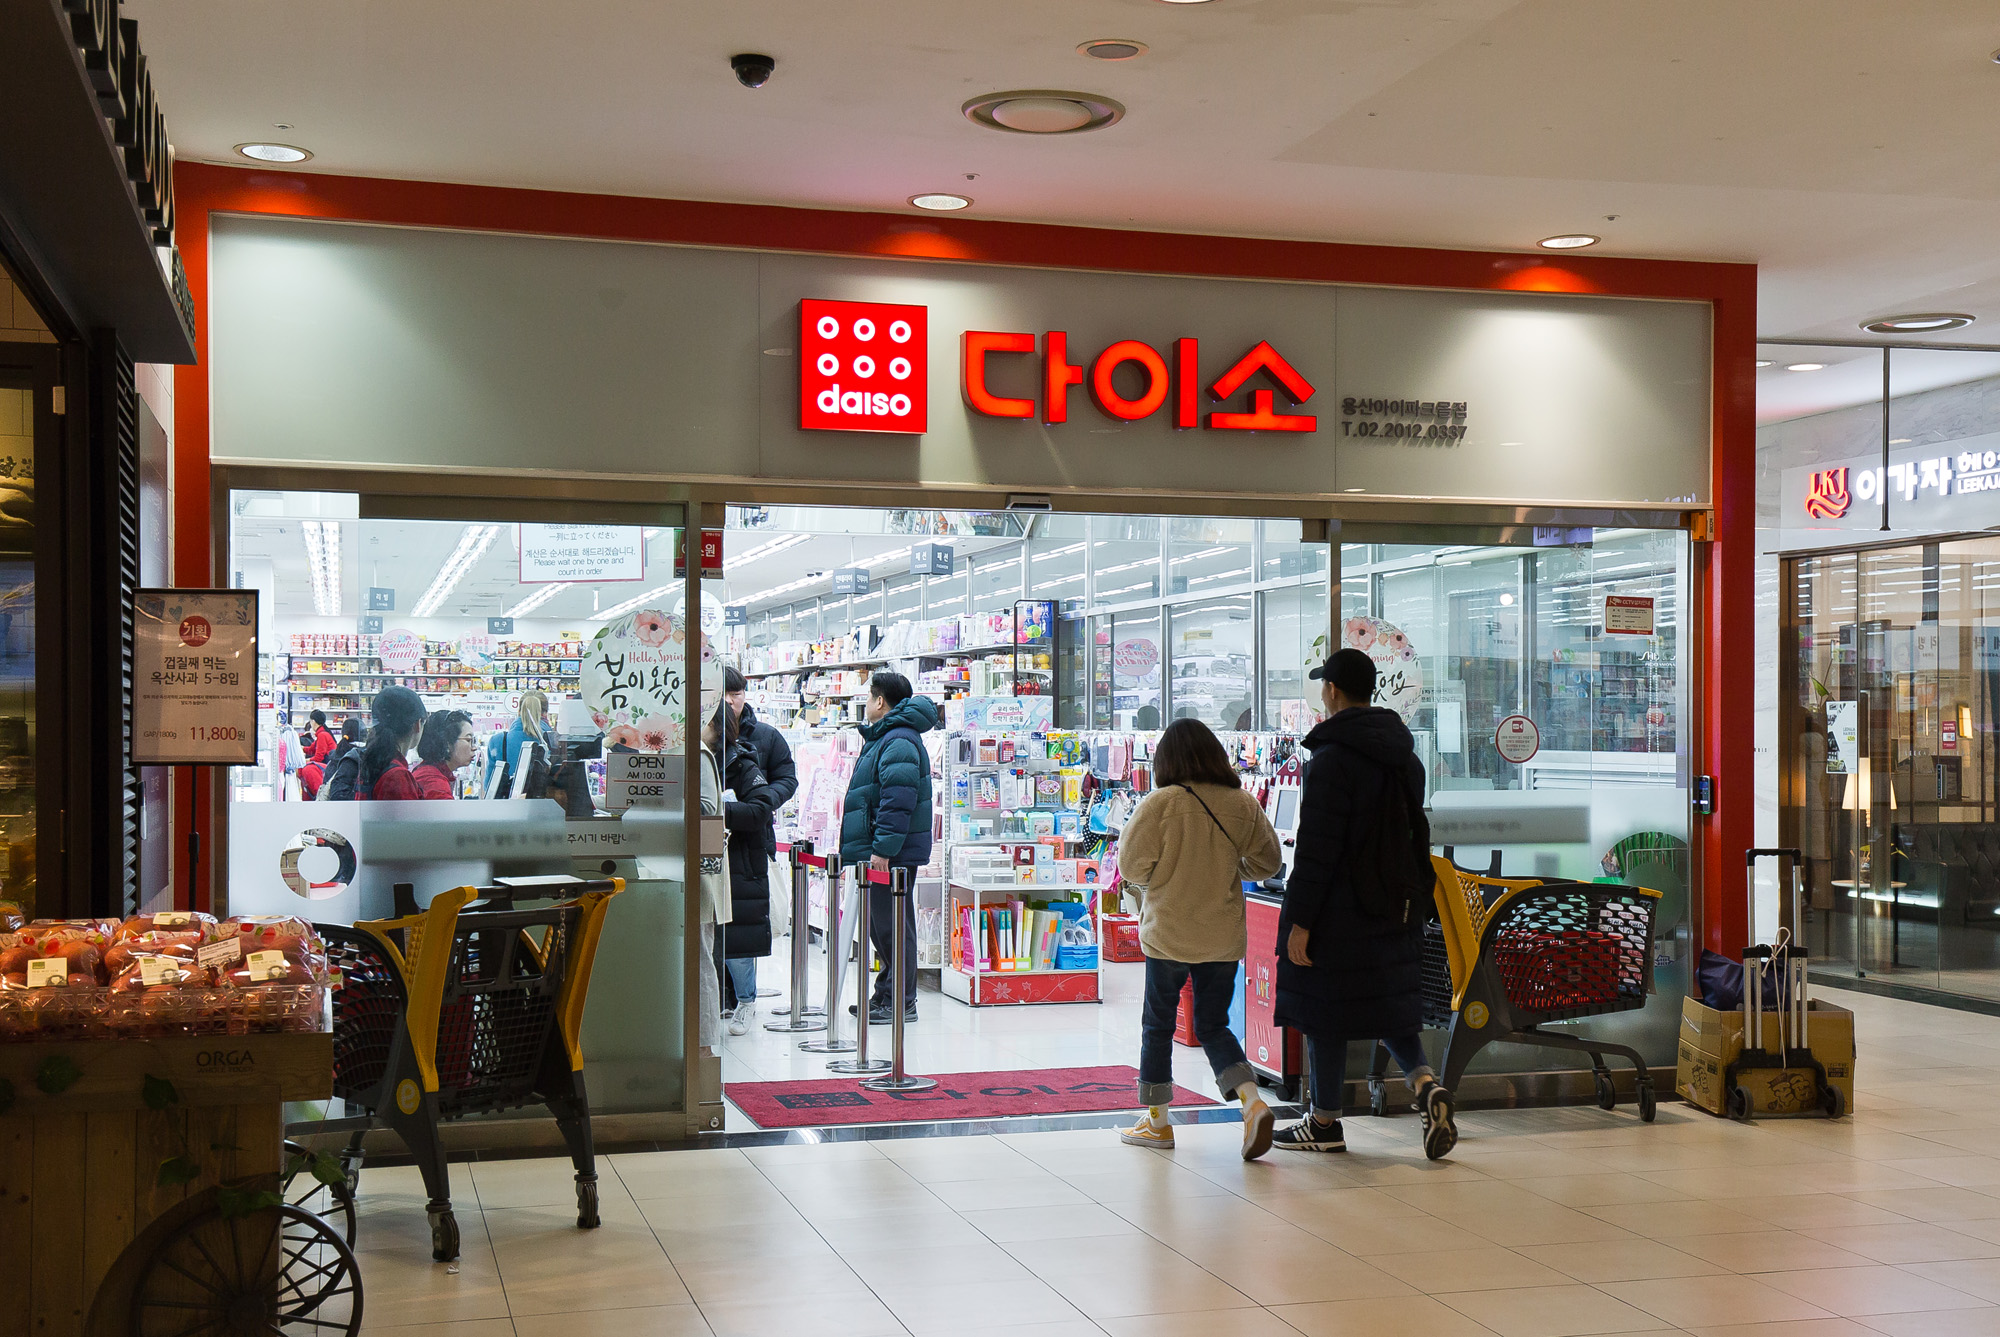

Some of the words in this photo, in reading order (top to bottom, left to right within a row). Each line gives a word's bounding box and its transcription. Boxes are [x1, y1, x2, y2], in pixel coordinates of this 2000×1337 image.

[960, 330, 1317, 432] 다이소
[817, 384, 911, 417] daiso
[1341, 397, 1467, 418] 용산아이파크몰점
[1958, 474, 2000, 494] LEEKAJ
[525, 549, 547, 558] 계산은
[550, 548, 579, 558] 순서대로
[534, 559, 556, 567] Please
[558, 558, 571, 566] wait
[586, 558, 594, 567] by
[578, 568, 584, 576] in
[586, 568, 603, 576] order
[164, 657, 199, 670] 껍질째
[203, 657, 227, 670] 먹는
[629, 652, 656, 663] Hello,
[151, 672, 198, 685] 옥산사과
[204, 672, 239, 685] 5-8입
[511, 697, 519, 709] 5
[759, 694, 766, 704] 2
[190, 726, 246, 742] 11,800원
[628, 756, 665, 769] OPEN
[627, 772, 640, 780] AM
[642, 771, 666, 780] 10:00
[628, 785, 664, 796] CLOSE
[567, 833, 598, 844] 주시기
[196, 1049, 255, 1067] ORGA
